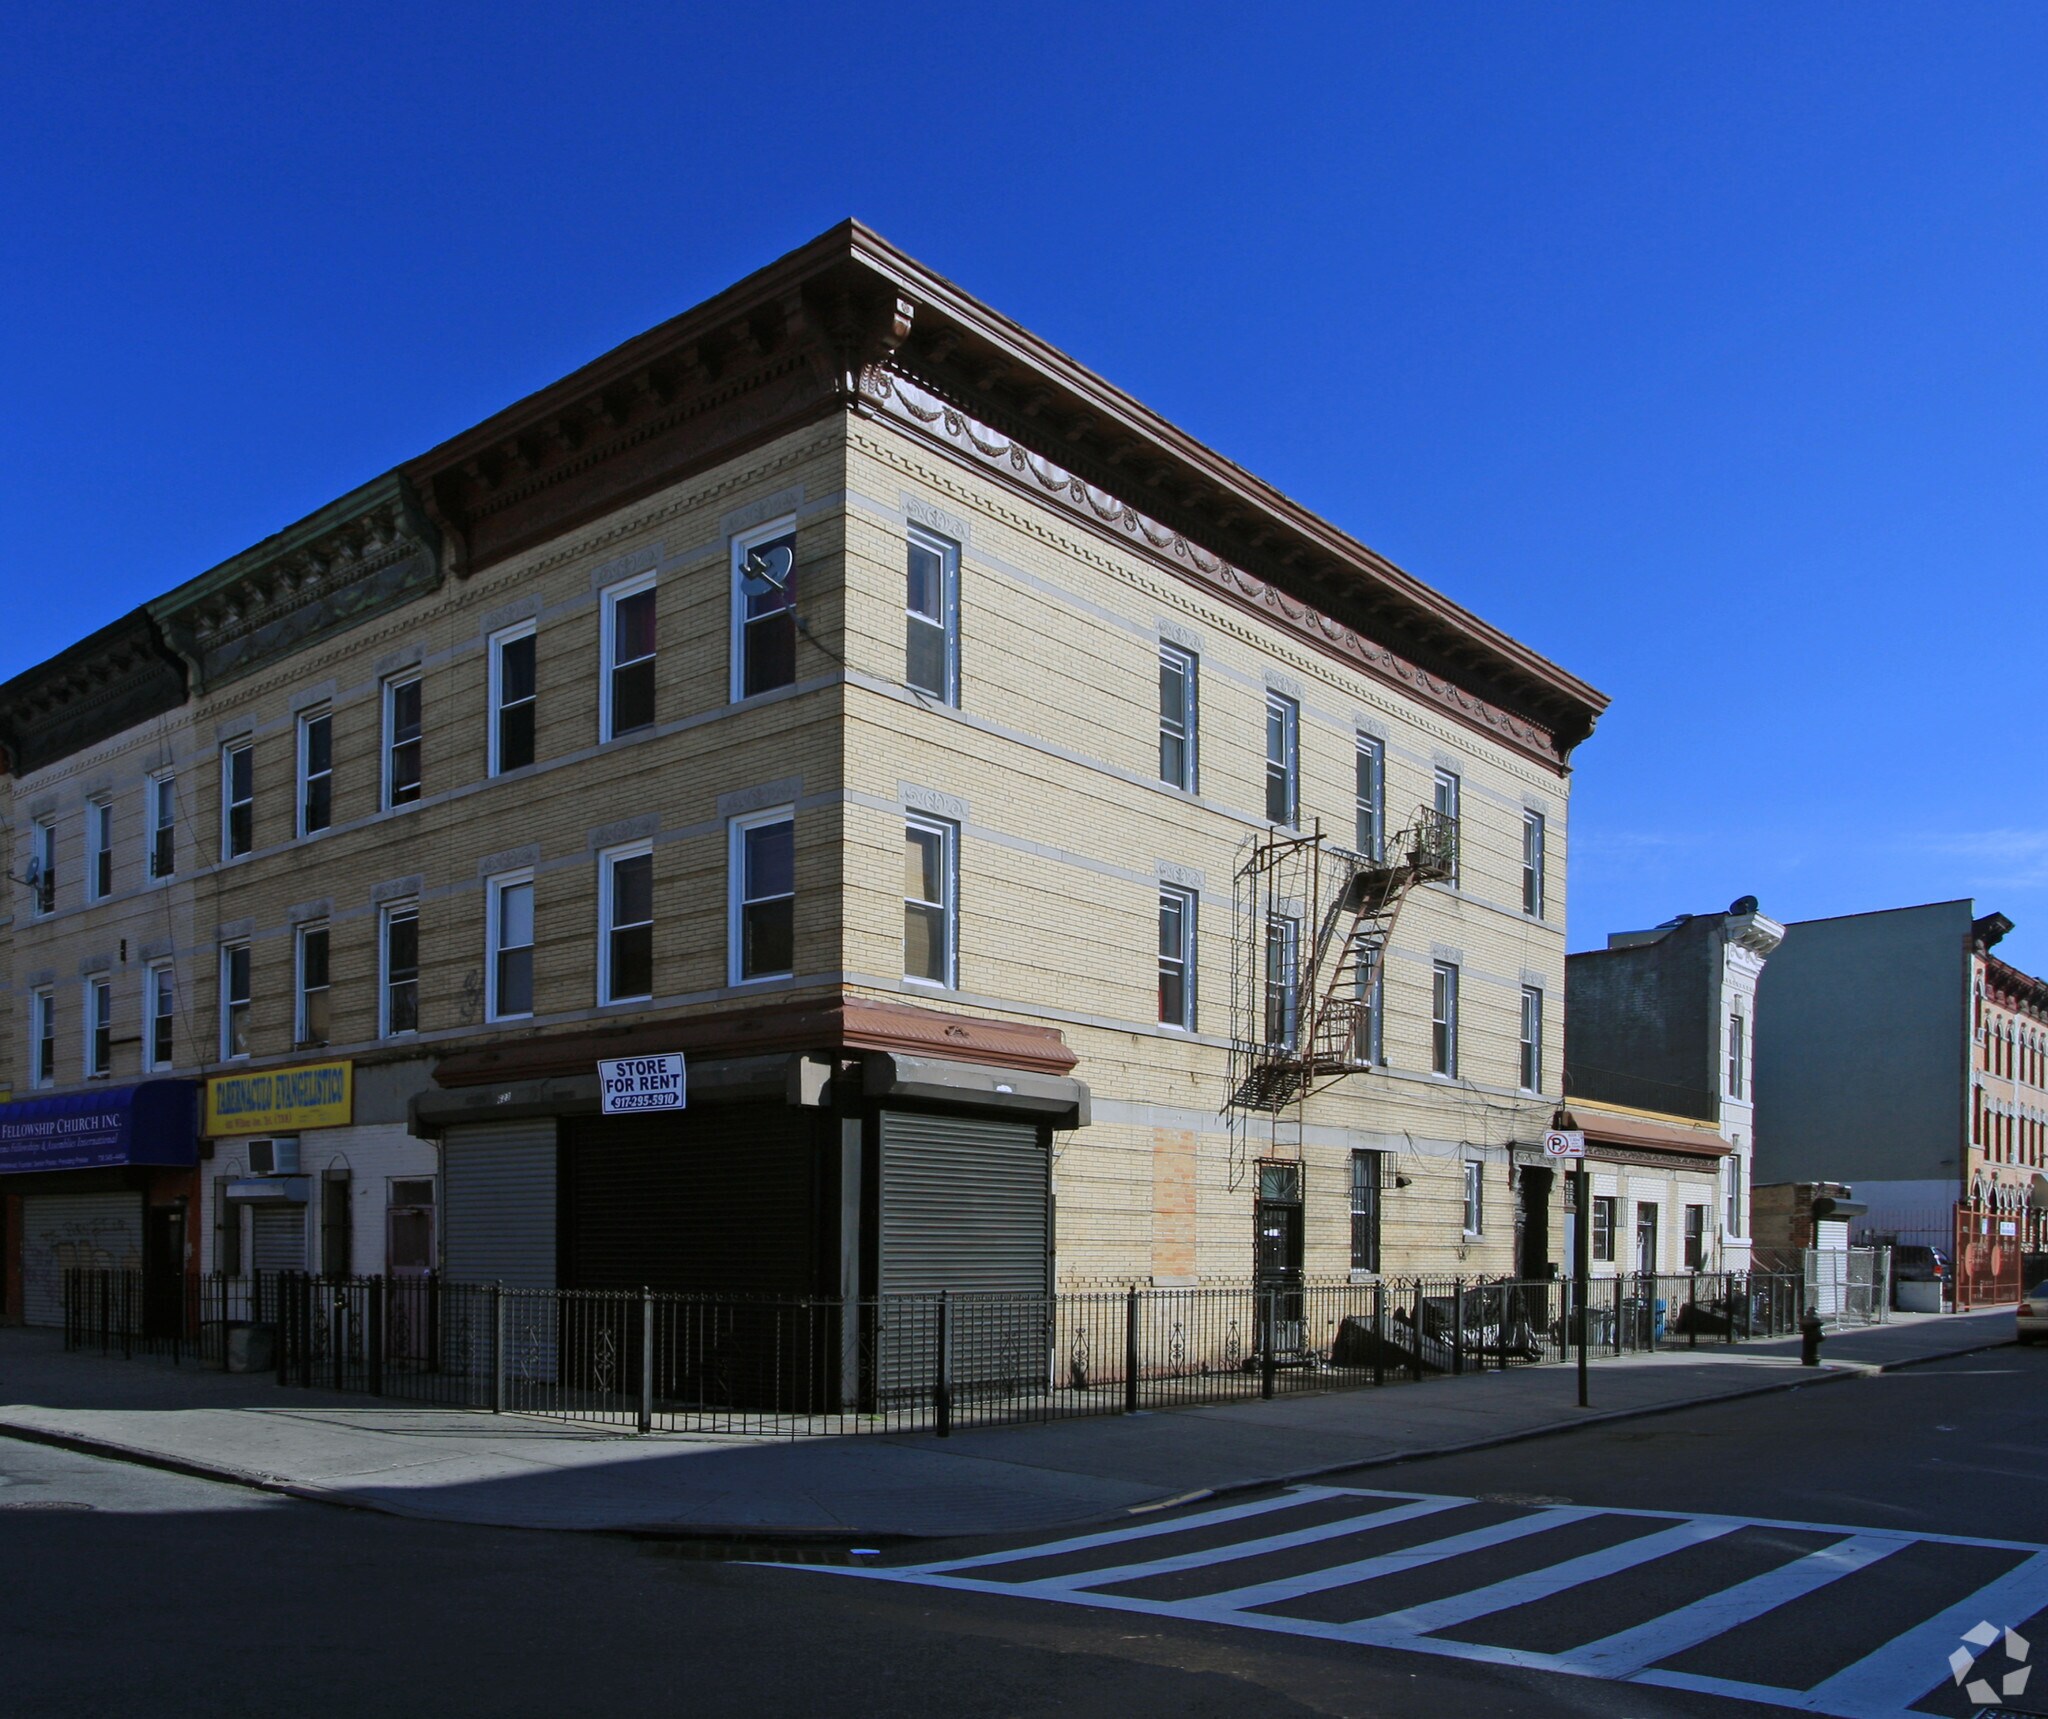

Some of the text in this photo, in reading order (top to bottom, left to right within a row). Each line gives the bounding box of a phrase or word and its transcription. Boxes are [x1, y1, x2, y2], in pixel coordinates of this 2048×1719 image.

[616, 1059, 667, 1077] STORE
[275, 1067, 343, 1110] EVANGELISTICO
[606, 1074, 680, 1093] FOR RENT
[614, 1093, 674, 1108] 917-295-5910
[2, 1113, 122, 1139] FELLOWSHIP CHURCH INC.
